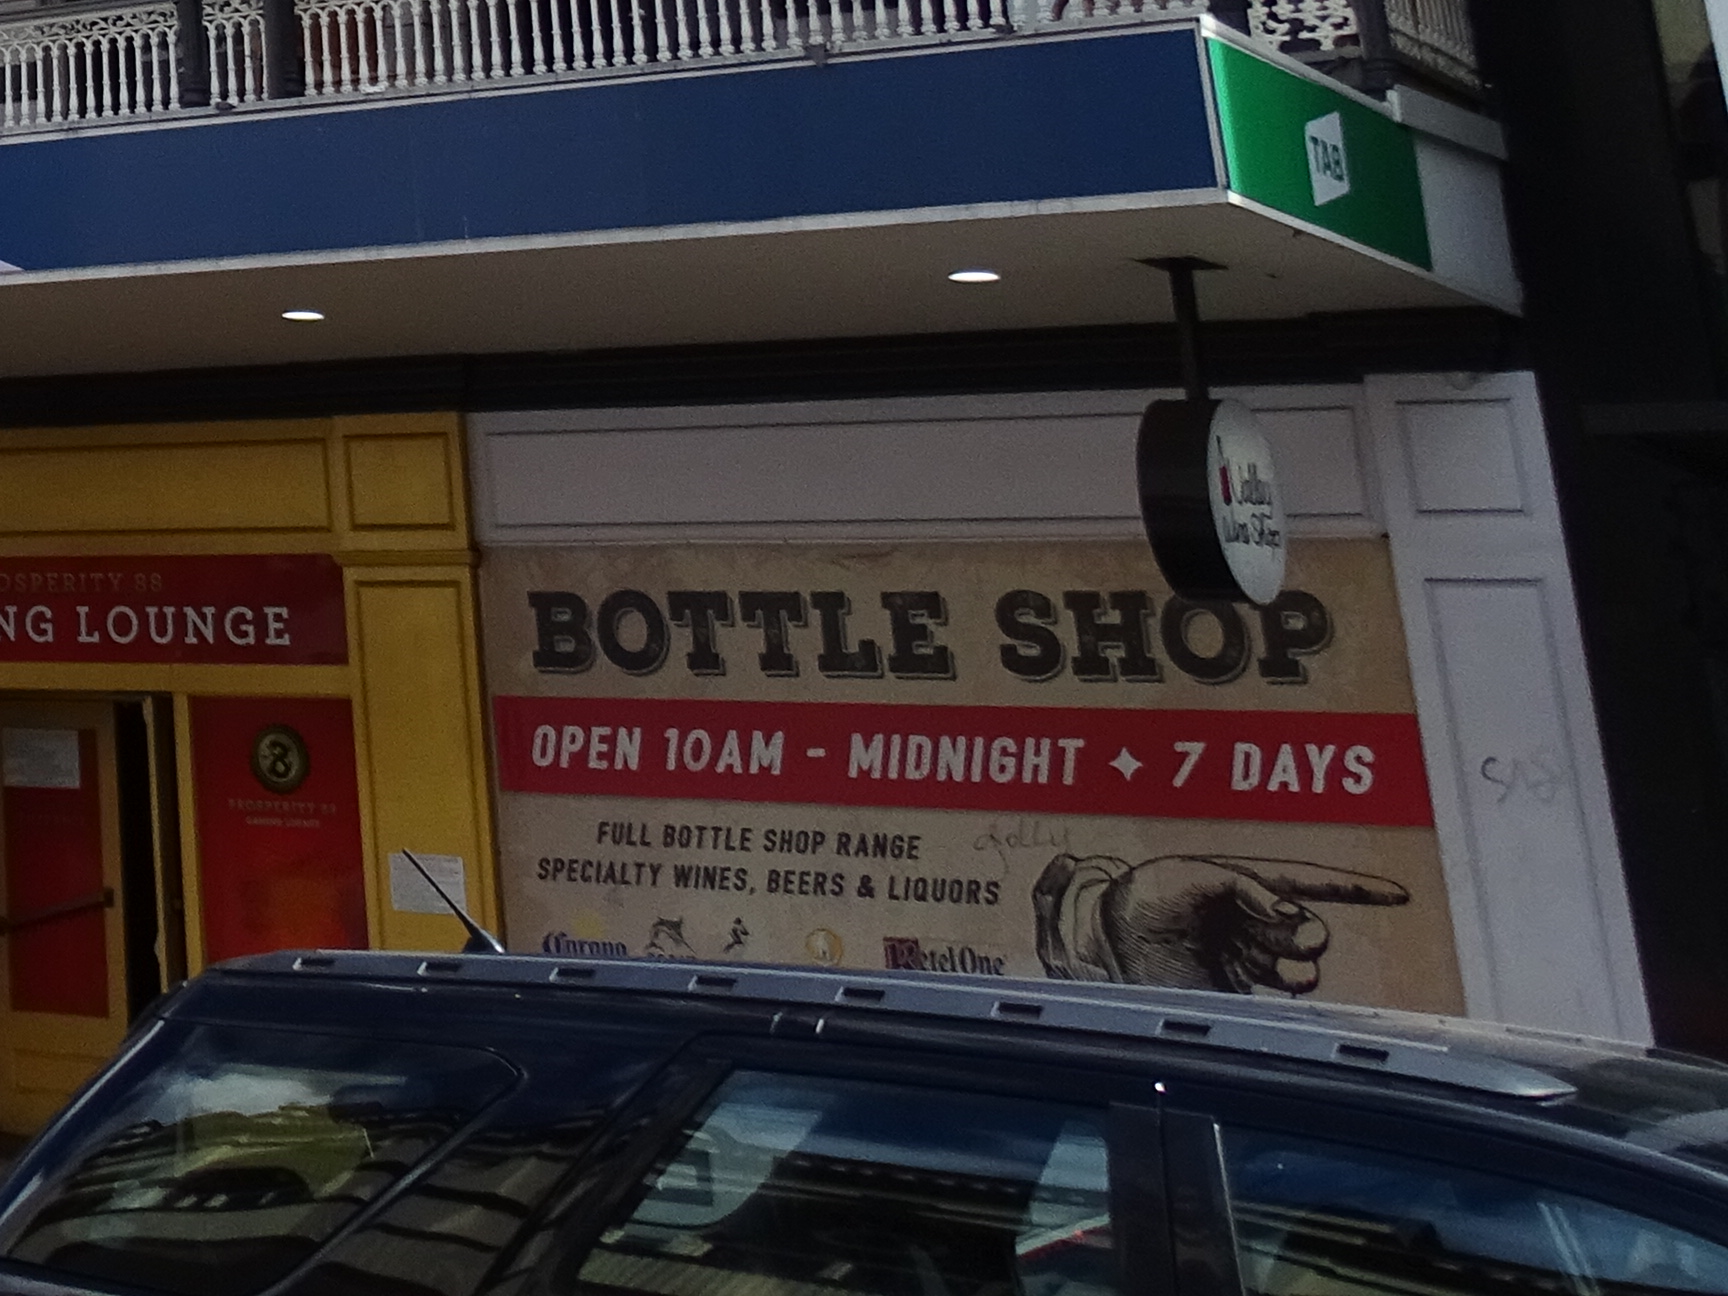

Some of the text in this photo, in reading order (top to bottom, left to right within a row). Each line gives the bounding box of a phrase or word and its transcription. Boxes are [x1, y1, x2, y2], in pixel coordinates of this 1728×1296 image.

[1310, 135, 1345, 184] TAB
[134, 572, 163, 593] 88
[76, 605, 291, 647] LOUNGE
[527, 589, 1335, 686] BOTTLE SHOP
[531, 723, 1376, 796] OPEN 10AM - MIDNIGHT 7 DAYS
[596, 819, 922, 861] FULL BOTTLE SHOP RANGE
[536, 857, 1001, 906] SPECIALTY WINES, BEERS & LIQUORS
